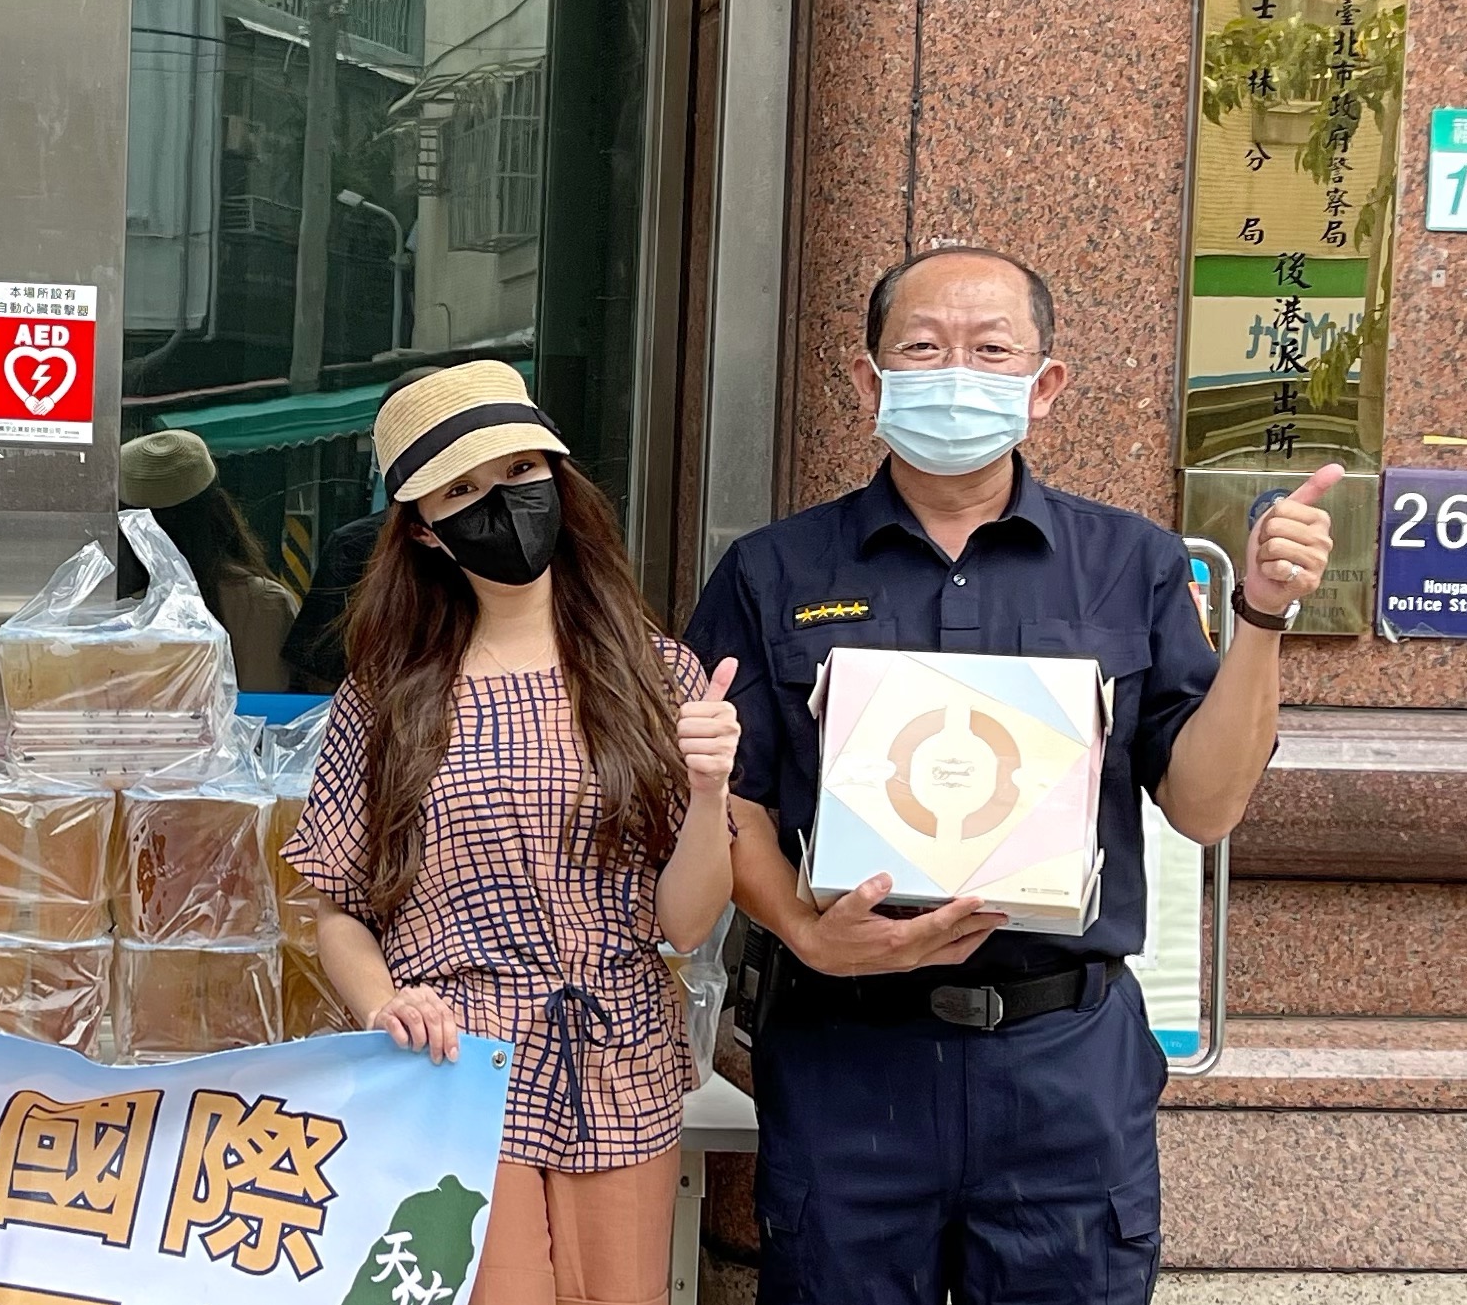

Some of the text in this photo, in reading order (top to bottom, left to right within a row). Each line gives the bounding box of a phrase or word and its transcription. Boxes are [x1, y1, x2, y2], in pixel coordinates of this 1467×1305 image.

[10, 286, 76, 301] 本場所設有
[14, 323, 70, 346] AED
[1264, 251, 1312, 460] 後港派出所
[1390, 492, 1467, 550] 26
[1388, 596, 1443, 611] Police
